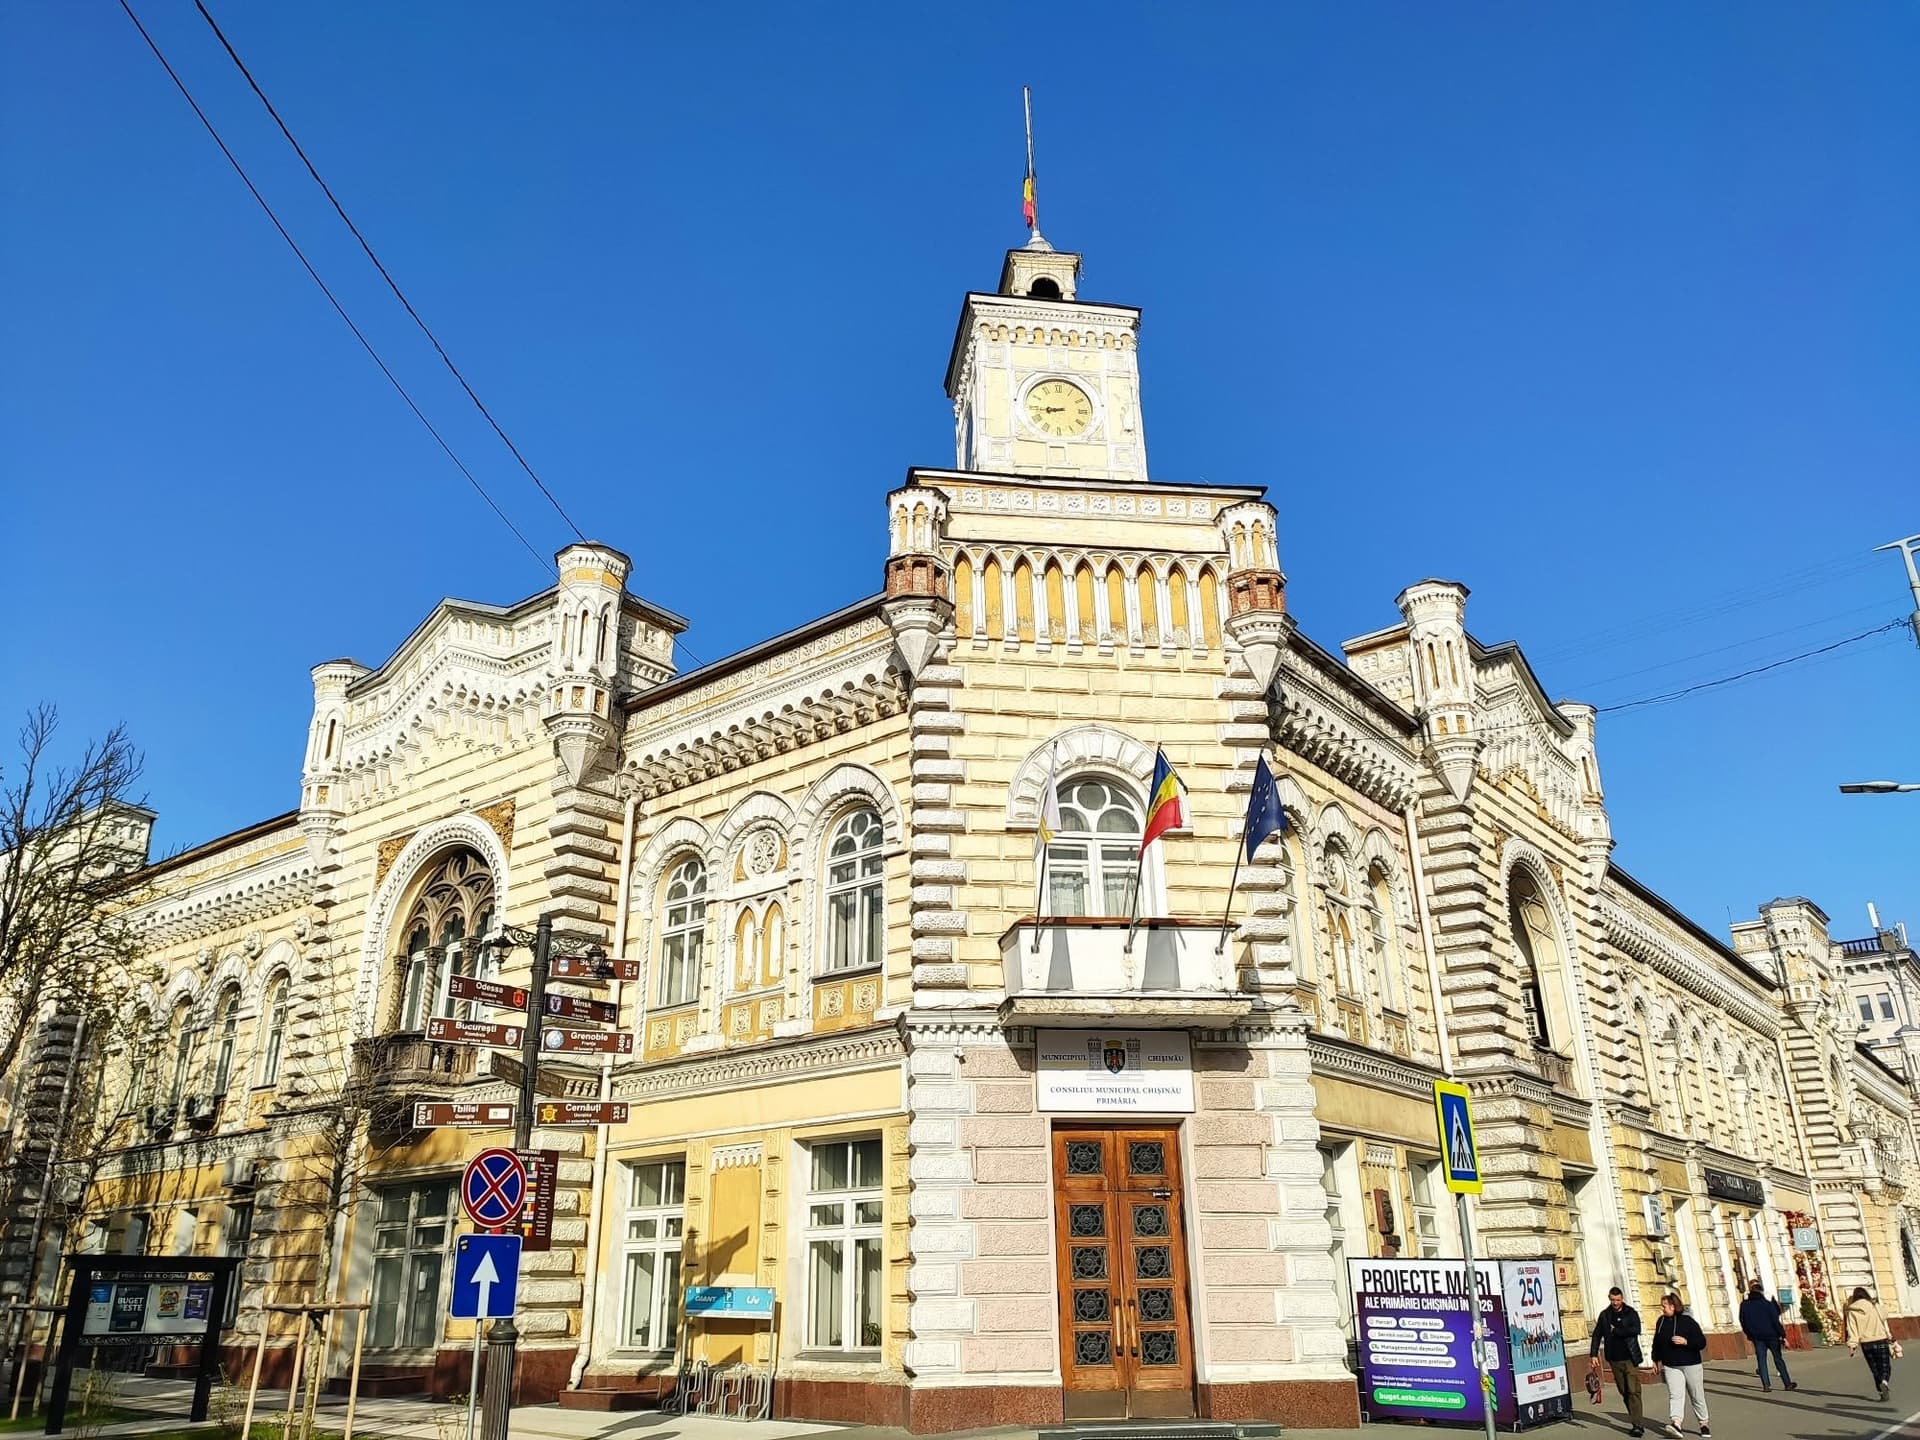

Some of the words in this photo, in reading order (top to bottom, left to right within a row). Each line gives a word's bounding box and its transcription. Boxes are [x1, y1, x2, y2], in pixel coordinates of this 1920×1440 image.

[475, 981, 504, 994] Odessa
[455, 1021, 497, 1034] București
[570, 1031, 609, 1042] Grenoble
[1147, 1054, 1184, 1064] CHIȘINĂU
[1050, 1086, 1094, 1094] CONSILIUL
[1095, 1086, 1141, 1094] MUNICIPAL
[1142, 1086, 1182, 1095] CHIȘINĂU
[452, 1104, 479, 1113] Tbilisi
[565, 1103, 602, 1114] Cernăuți
[1361, 1269, 1442, 1294] PROIECTE
[1445, 1270, 1492, 1295] MARI
[1518, 1277, 1543, 1307] 250
[1365, 1297, 1380, 1309] ALE
[1380, 1295, 1420, 1310] PRIMĂRIEI
[1421, 1297, 1459, 1312] CHIȘINĂU
[1459, 1297, 1470, 1311] ÎN
